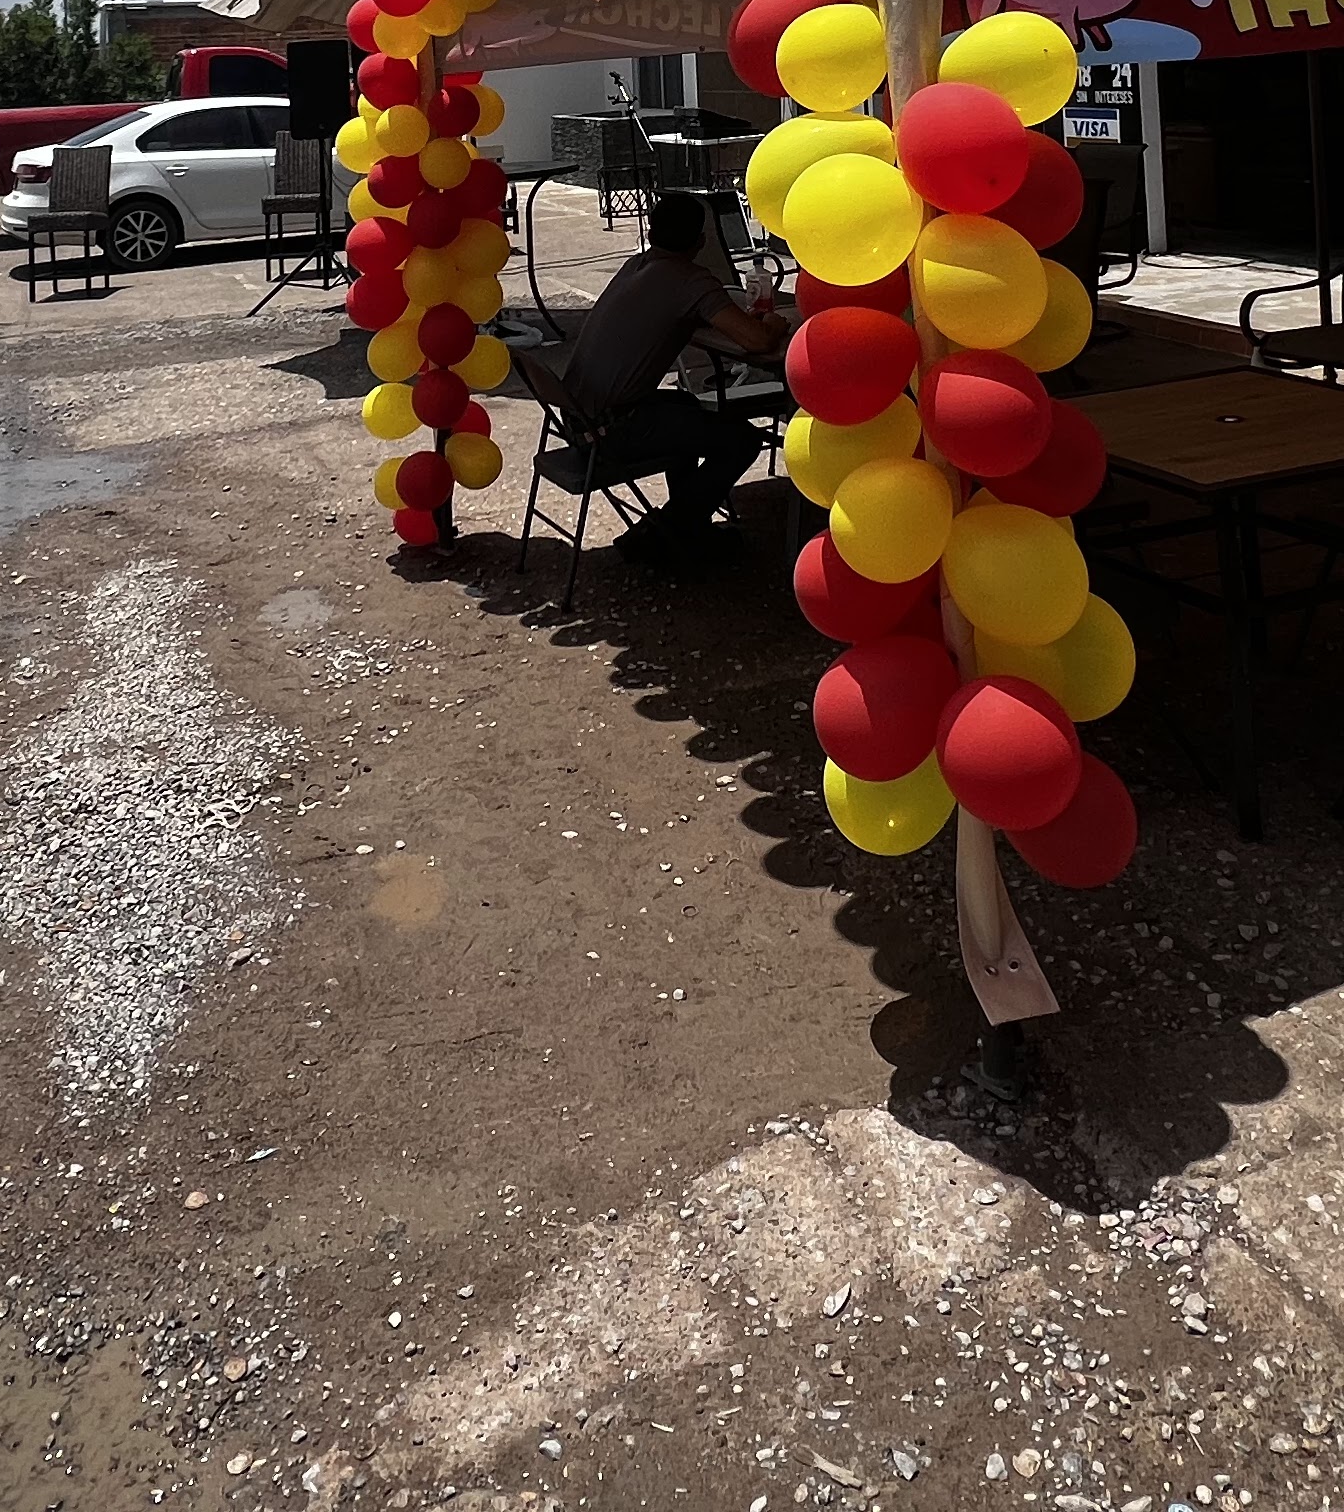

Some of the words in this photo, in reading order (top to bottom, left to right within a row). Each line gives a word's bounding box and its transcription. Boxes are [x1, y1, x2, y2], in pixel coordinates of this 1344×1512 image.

[1110, 63, 1132, 88] 24
[1076, 90, 1088, 103] SIN
[1094, 90, 1134, 104] INTERESES
[1072, 120, 1110, 137] VISA
